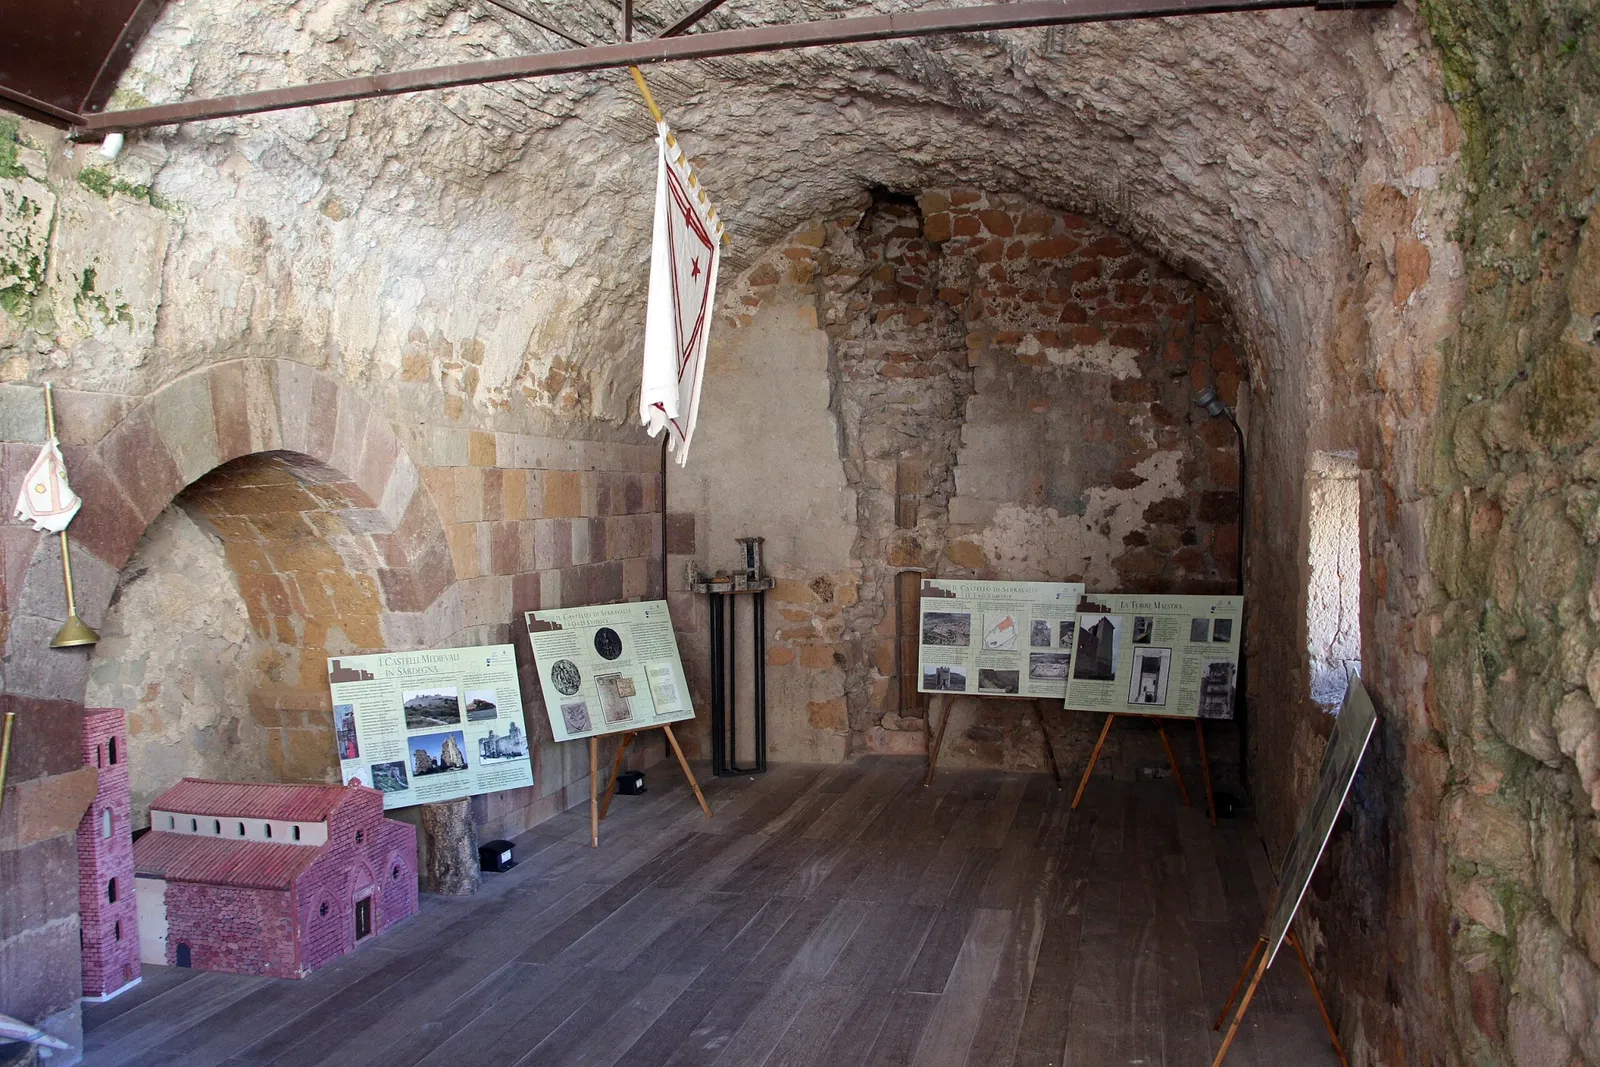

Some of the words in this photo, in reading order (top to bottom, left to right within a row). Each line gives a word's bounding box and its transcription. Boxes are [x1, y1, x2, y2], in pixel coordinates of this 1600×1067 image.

[1131, 600, 1151, 609] TORRE
[1153, 601, 1183, 610] MAESTRA
[384, 656, 420, 667] CASTELLI
[421, 653, 460, 664] MEDIEVALI
[397, 665, 439, 676] SARDEGNA
